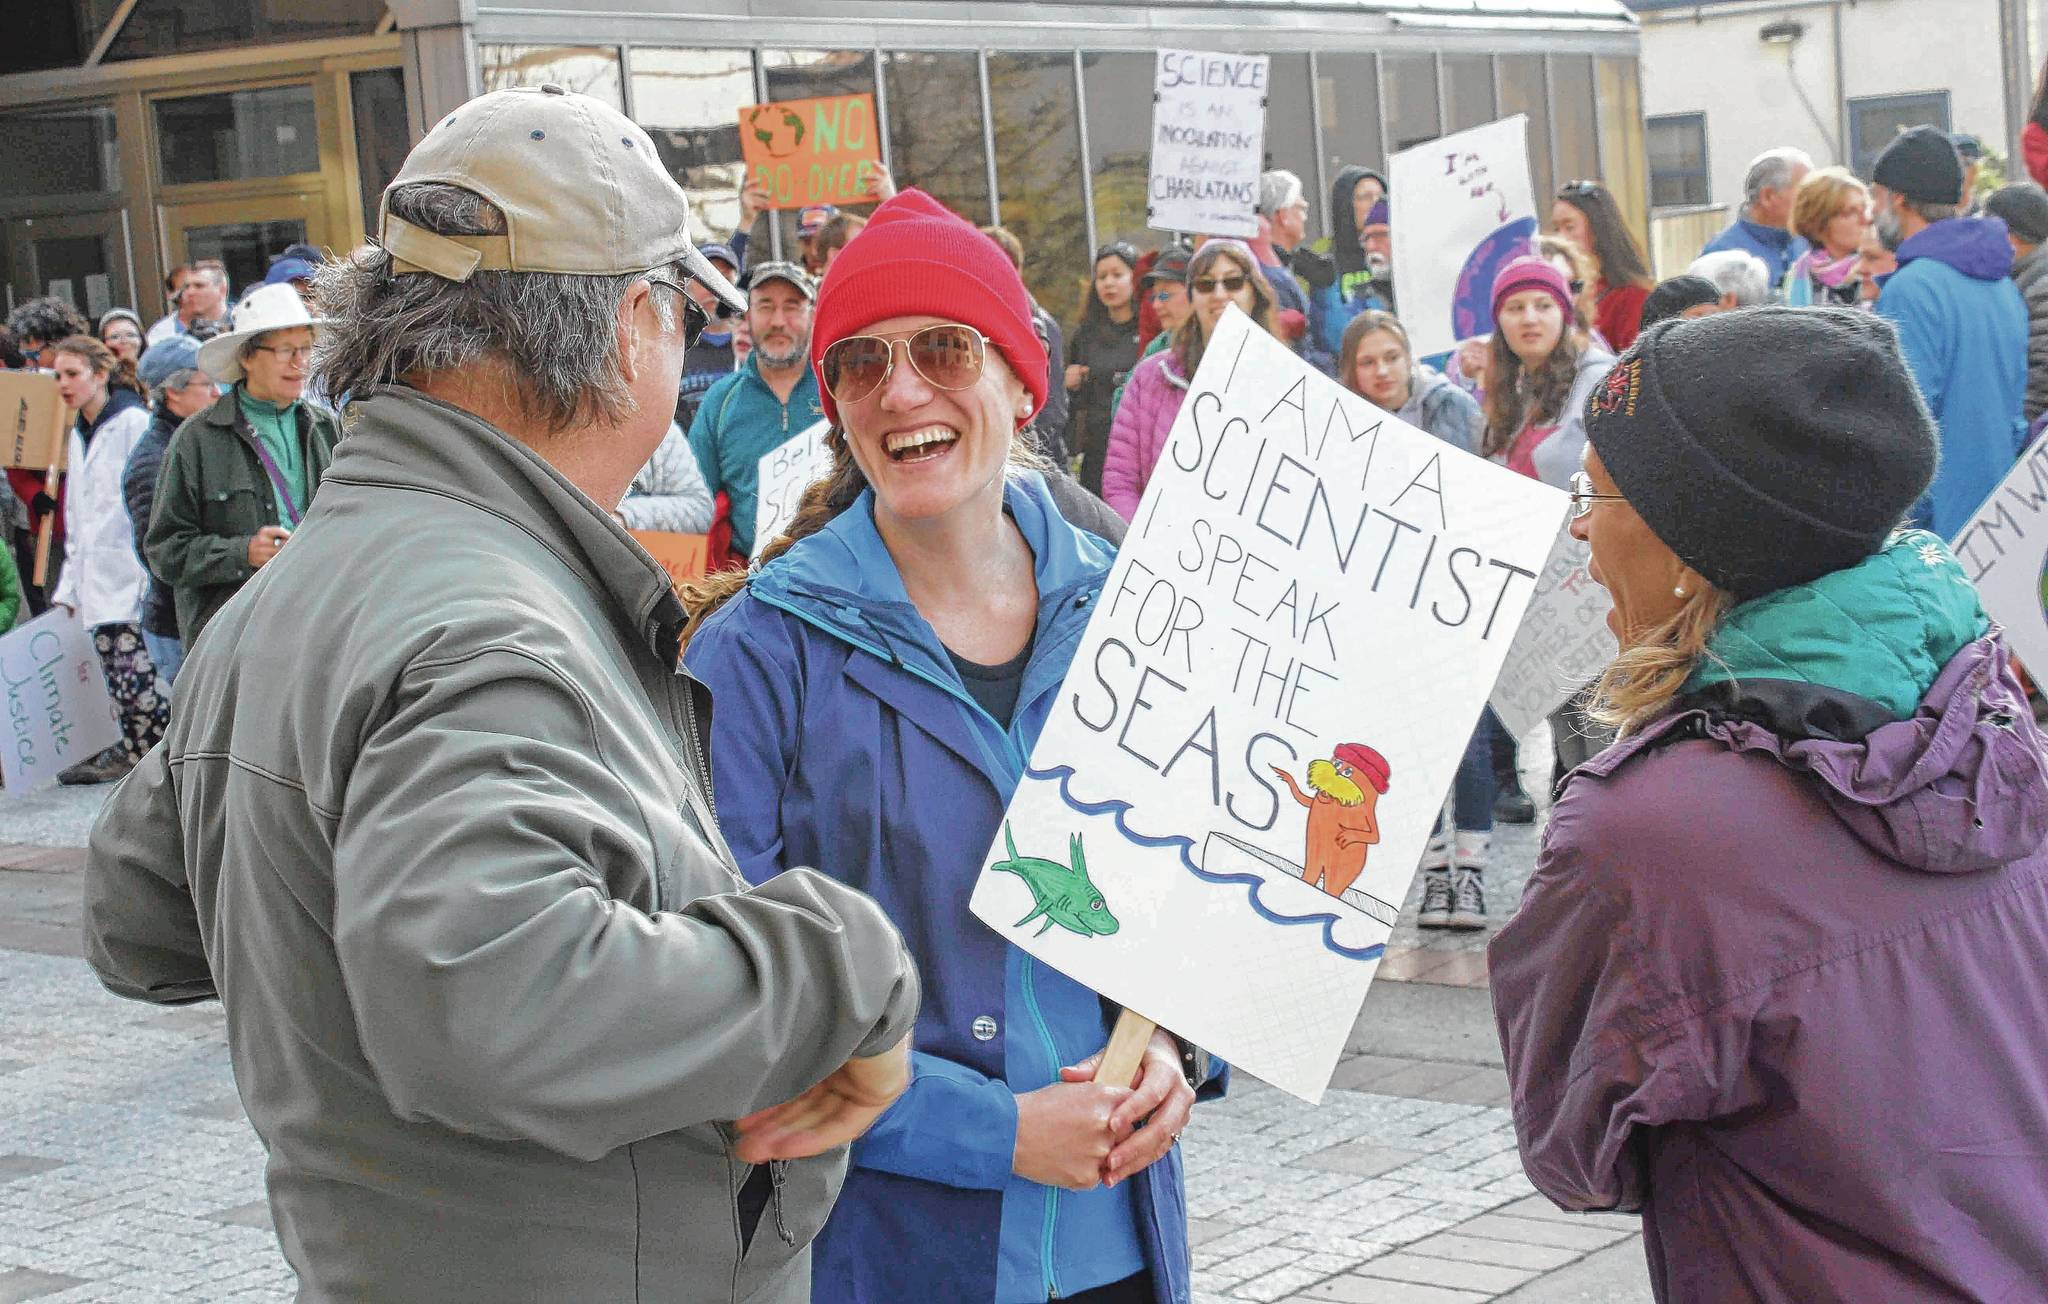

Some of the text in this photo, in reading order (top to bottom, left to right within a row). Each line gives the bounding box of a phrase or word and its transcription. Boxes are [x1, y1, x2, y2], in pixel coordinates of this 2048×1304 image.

[813, 97, 867, 155] NO
[1161, 52, 1265, 89] SCIENCE
[1172, 391, 1538, 641] SCIENTIST
[1224, 328, 1447, 531] I AM A
[1109, 558, 1340, 738] FOR THE
[1142, 487, 1341, 662] I SPEAK
[0, 655, 37, 777] Justice
[29, 630, 75, 757] Climate
[1072, 636, 1299, 832] SEAS
